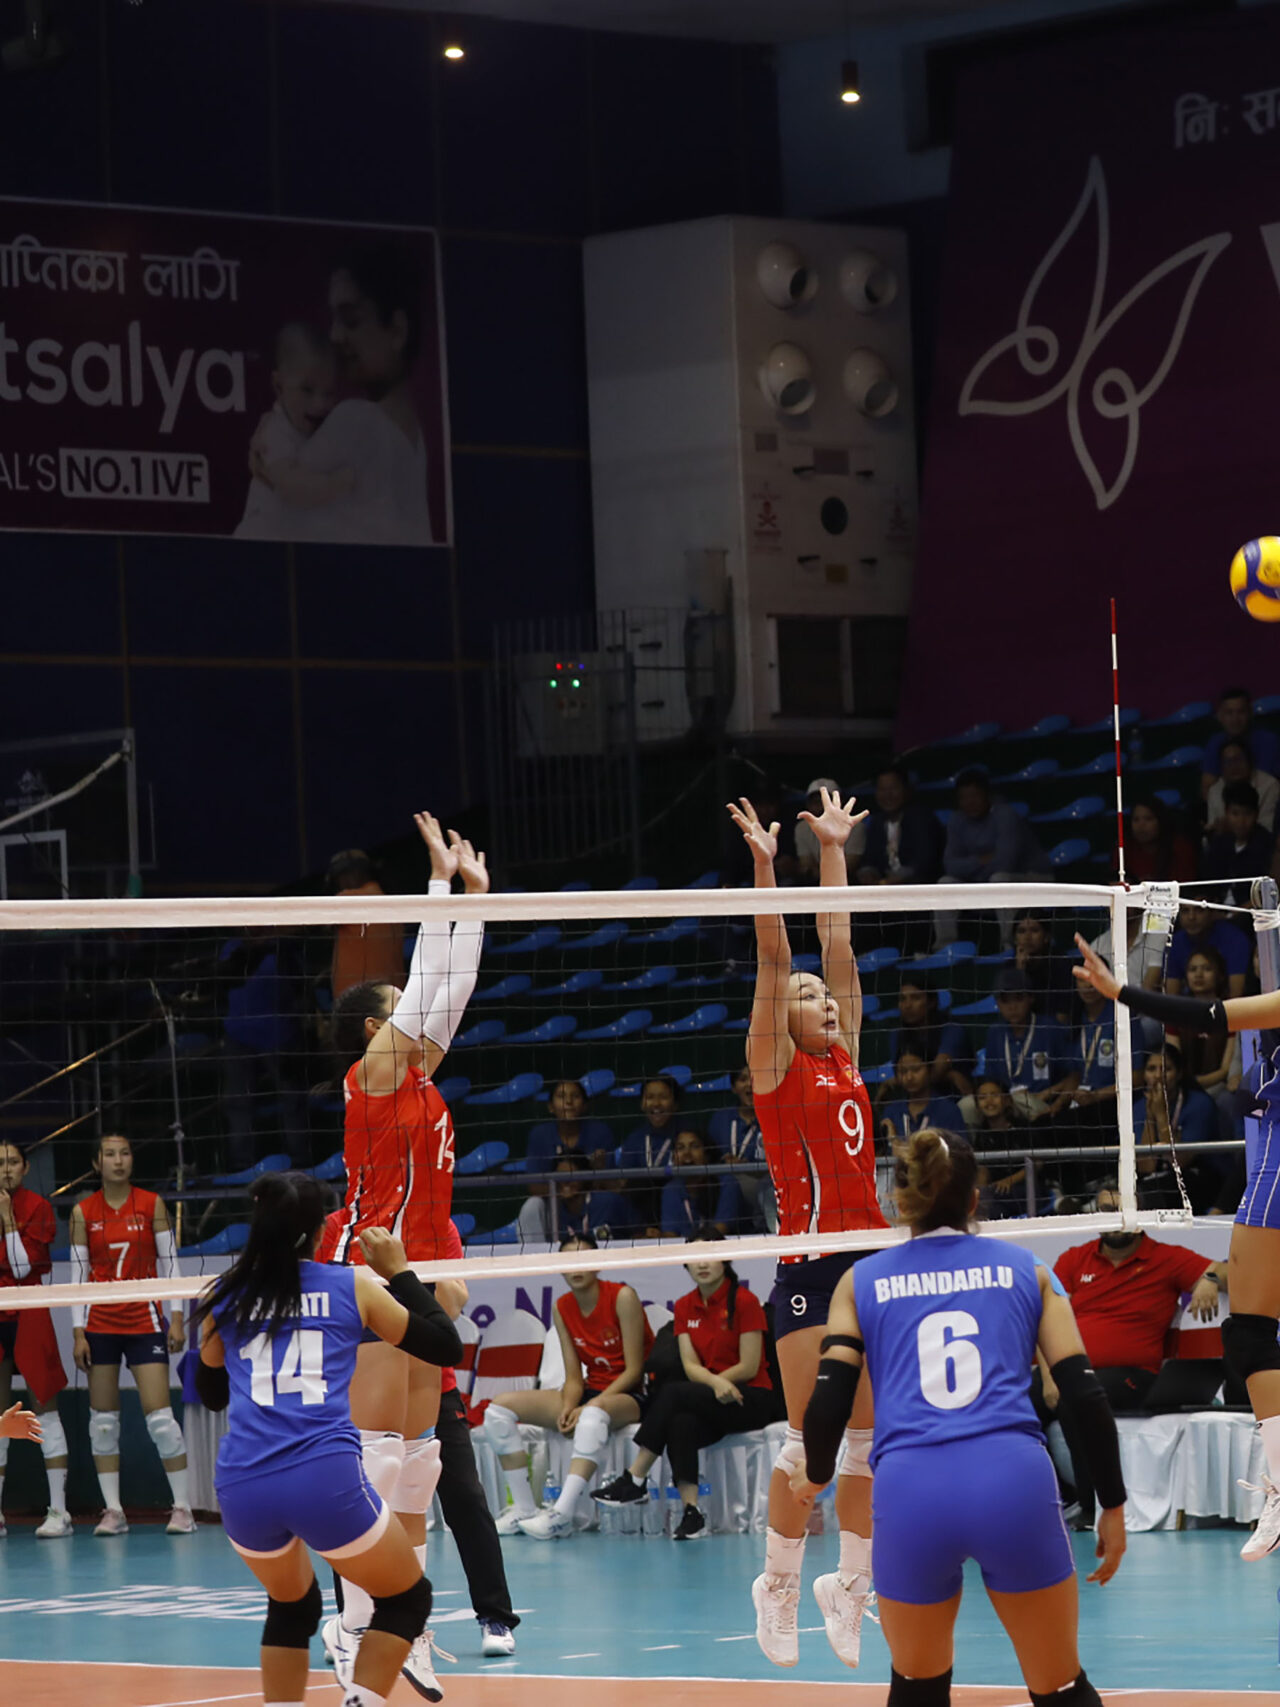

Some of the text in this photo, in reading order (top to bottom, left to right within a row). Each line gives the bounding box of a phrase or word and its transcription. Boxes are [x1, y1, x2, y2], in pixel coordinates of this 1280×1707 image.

[140, 246, 241, 301] लागि
[66, 456, 142, 495] NO.1
[152, 459, 204, 497] IVF
[838, 1099, 866, 1157] 9
[108, 1241, 130, 1279] 7
[790, 1294, 808, 1316] 9
[874, 1265, 1014, 1304] BHANDARI.U
[239, 1329, 328, 1407] 14
[916, 1310, 983, 1411] 6
